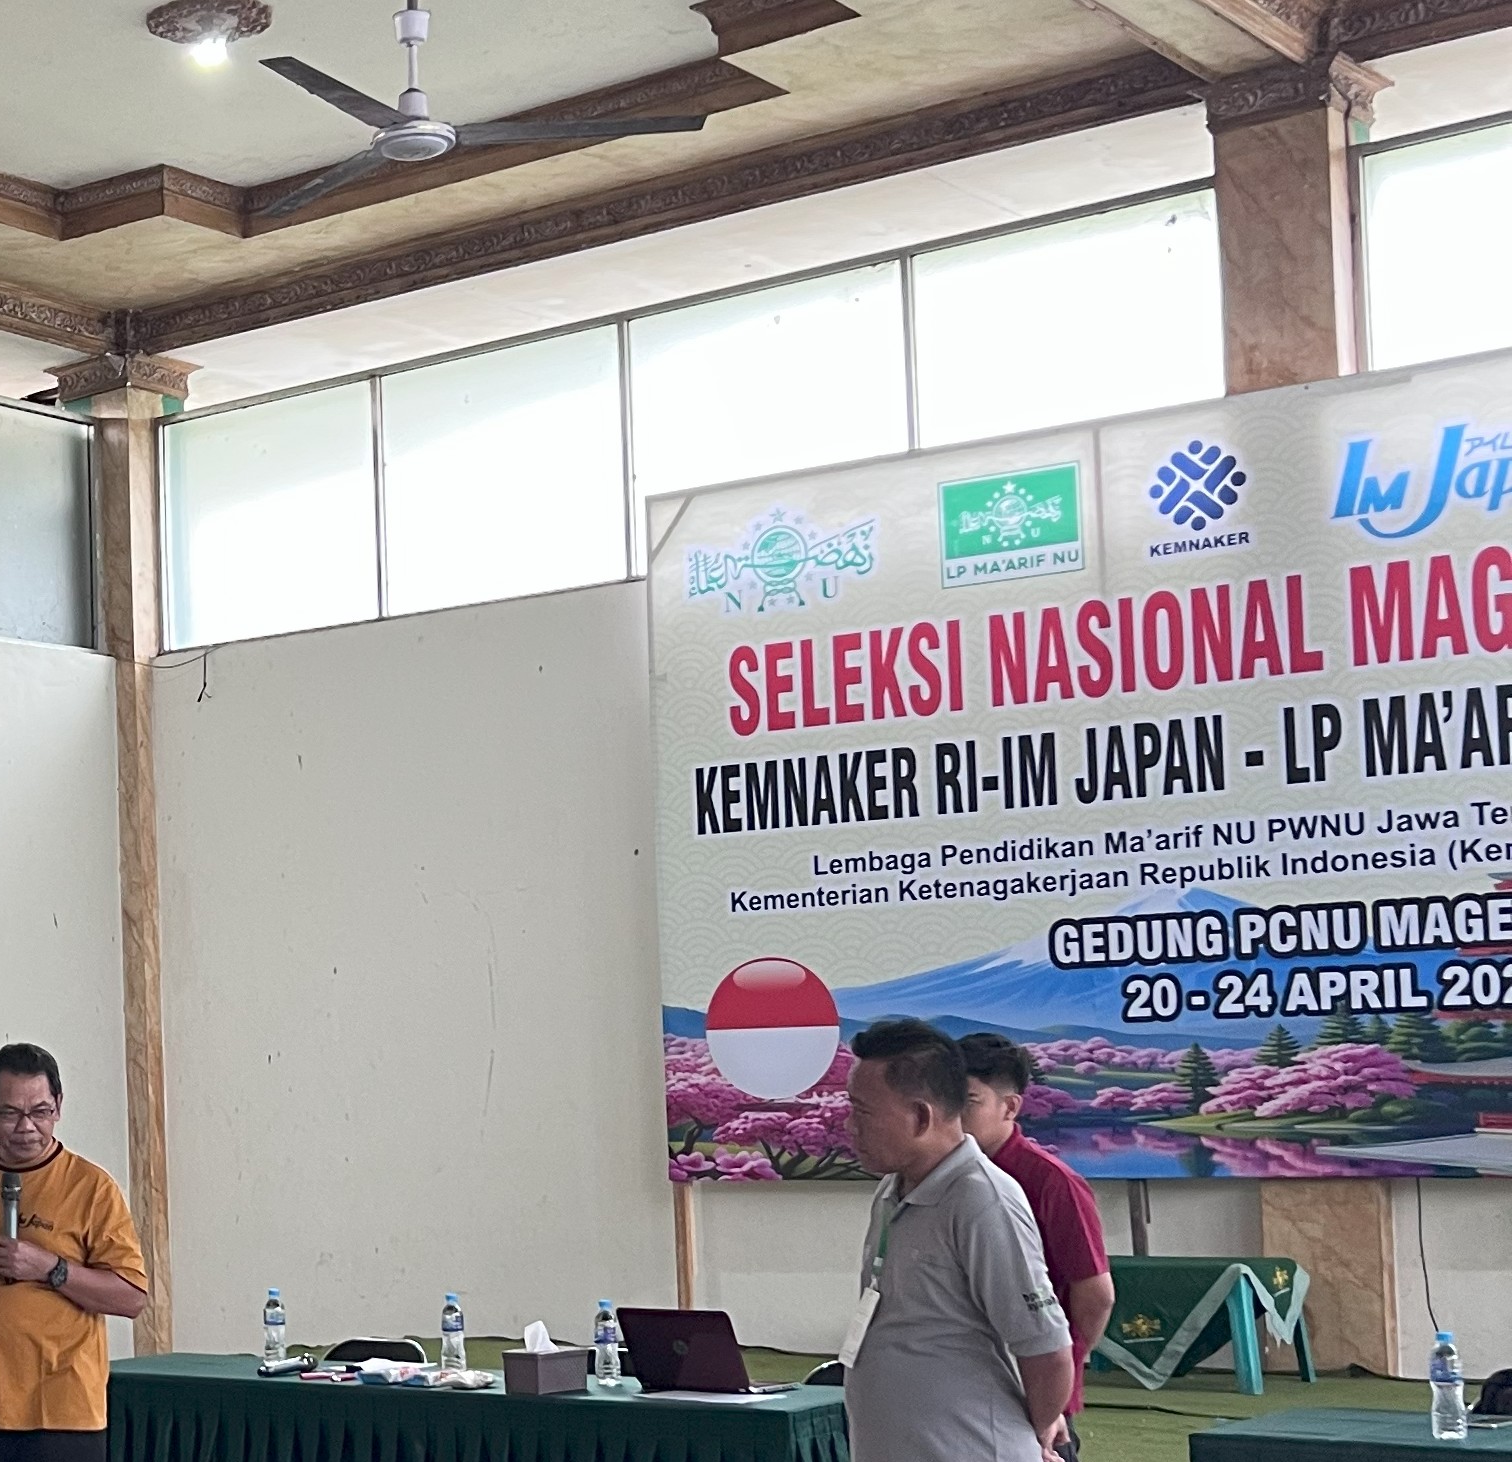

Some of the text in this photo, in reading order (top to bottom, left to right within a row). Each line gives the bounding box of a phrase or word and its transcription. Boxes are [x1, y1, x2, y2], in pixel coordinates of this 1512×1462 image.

[946, 549, 1080, 579] LP MA'ARIF NU
[1149, 531, 1250, 558] KEMNAKER
[729, 546, 1512, 736] SELEKSI NASIONAL MAG
[695, 746, 920, 836] KEMNAKER
[935, 732, 1058, 815] RI-IM
[1075, 714, 1225, 805] JAPAN
[1283, 703, 1342, 785] LP
[814, 801, 1512, 876] Lembaga Pendidikan Ma'arif NU PWNU Jawa Te
[730, 883, 888, 913] Kementerian
[899, 867, 1129, 902] Ketenagakerjaan
[1140, 856, 1270, 889] Republik
[1281, 842, 1436, 876] Indonesia
[1052, 897, 1512, 966] GEDUNG PCNU MAGE
[1125, 976, 1178, 1018] 20
[1217, 973, 1273, 1015] 24
[1285, 968, 1428, 1012] APRIL
